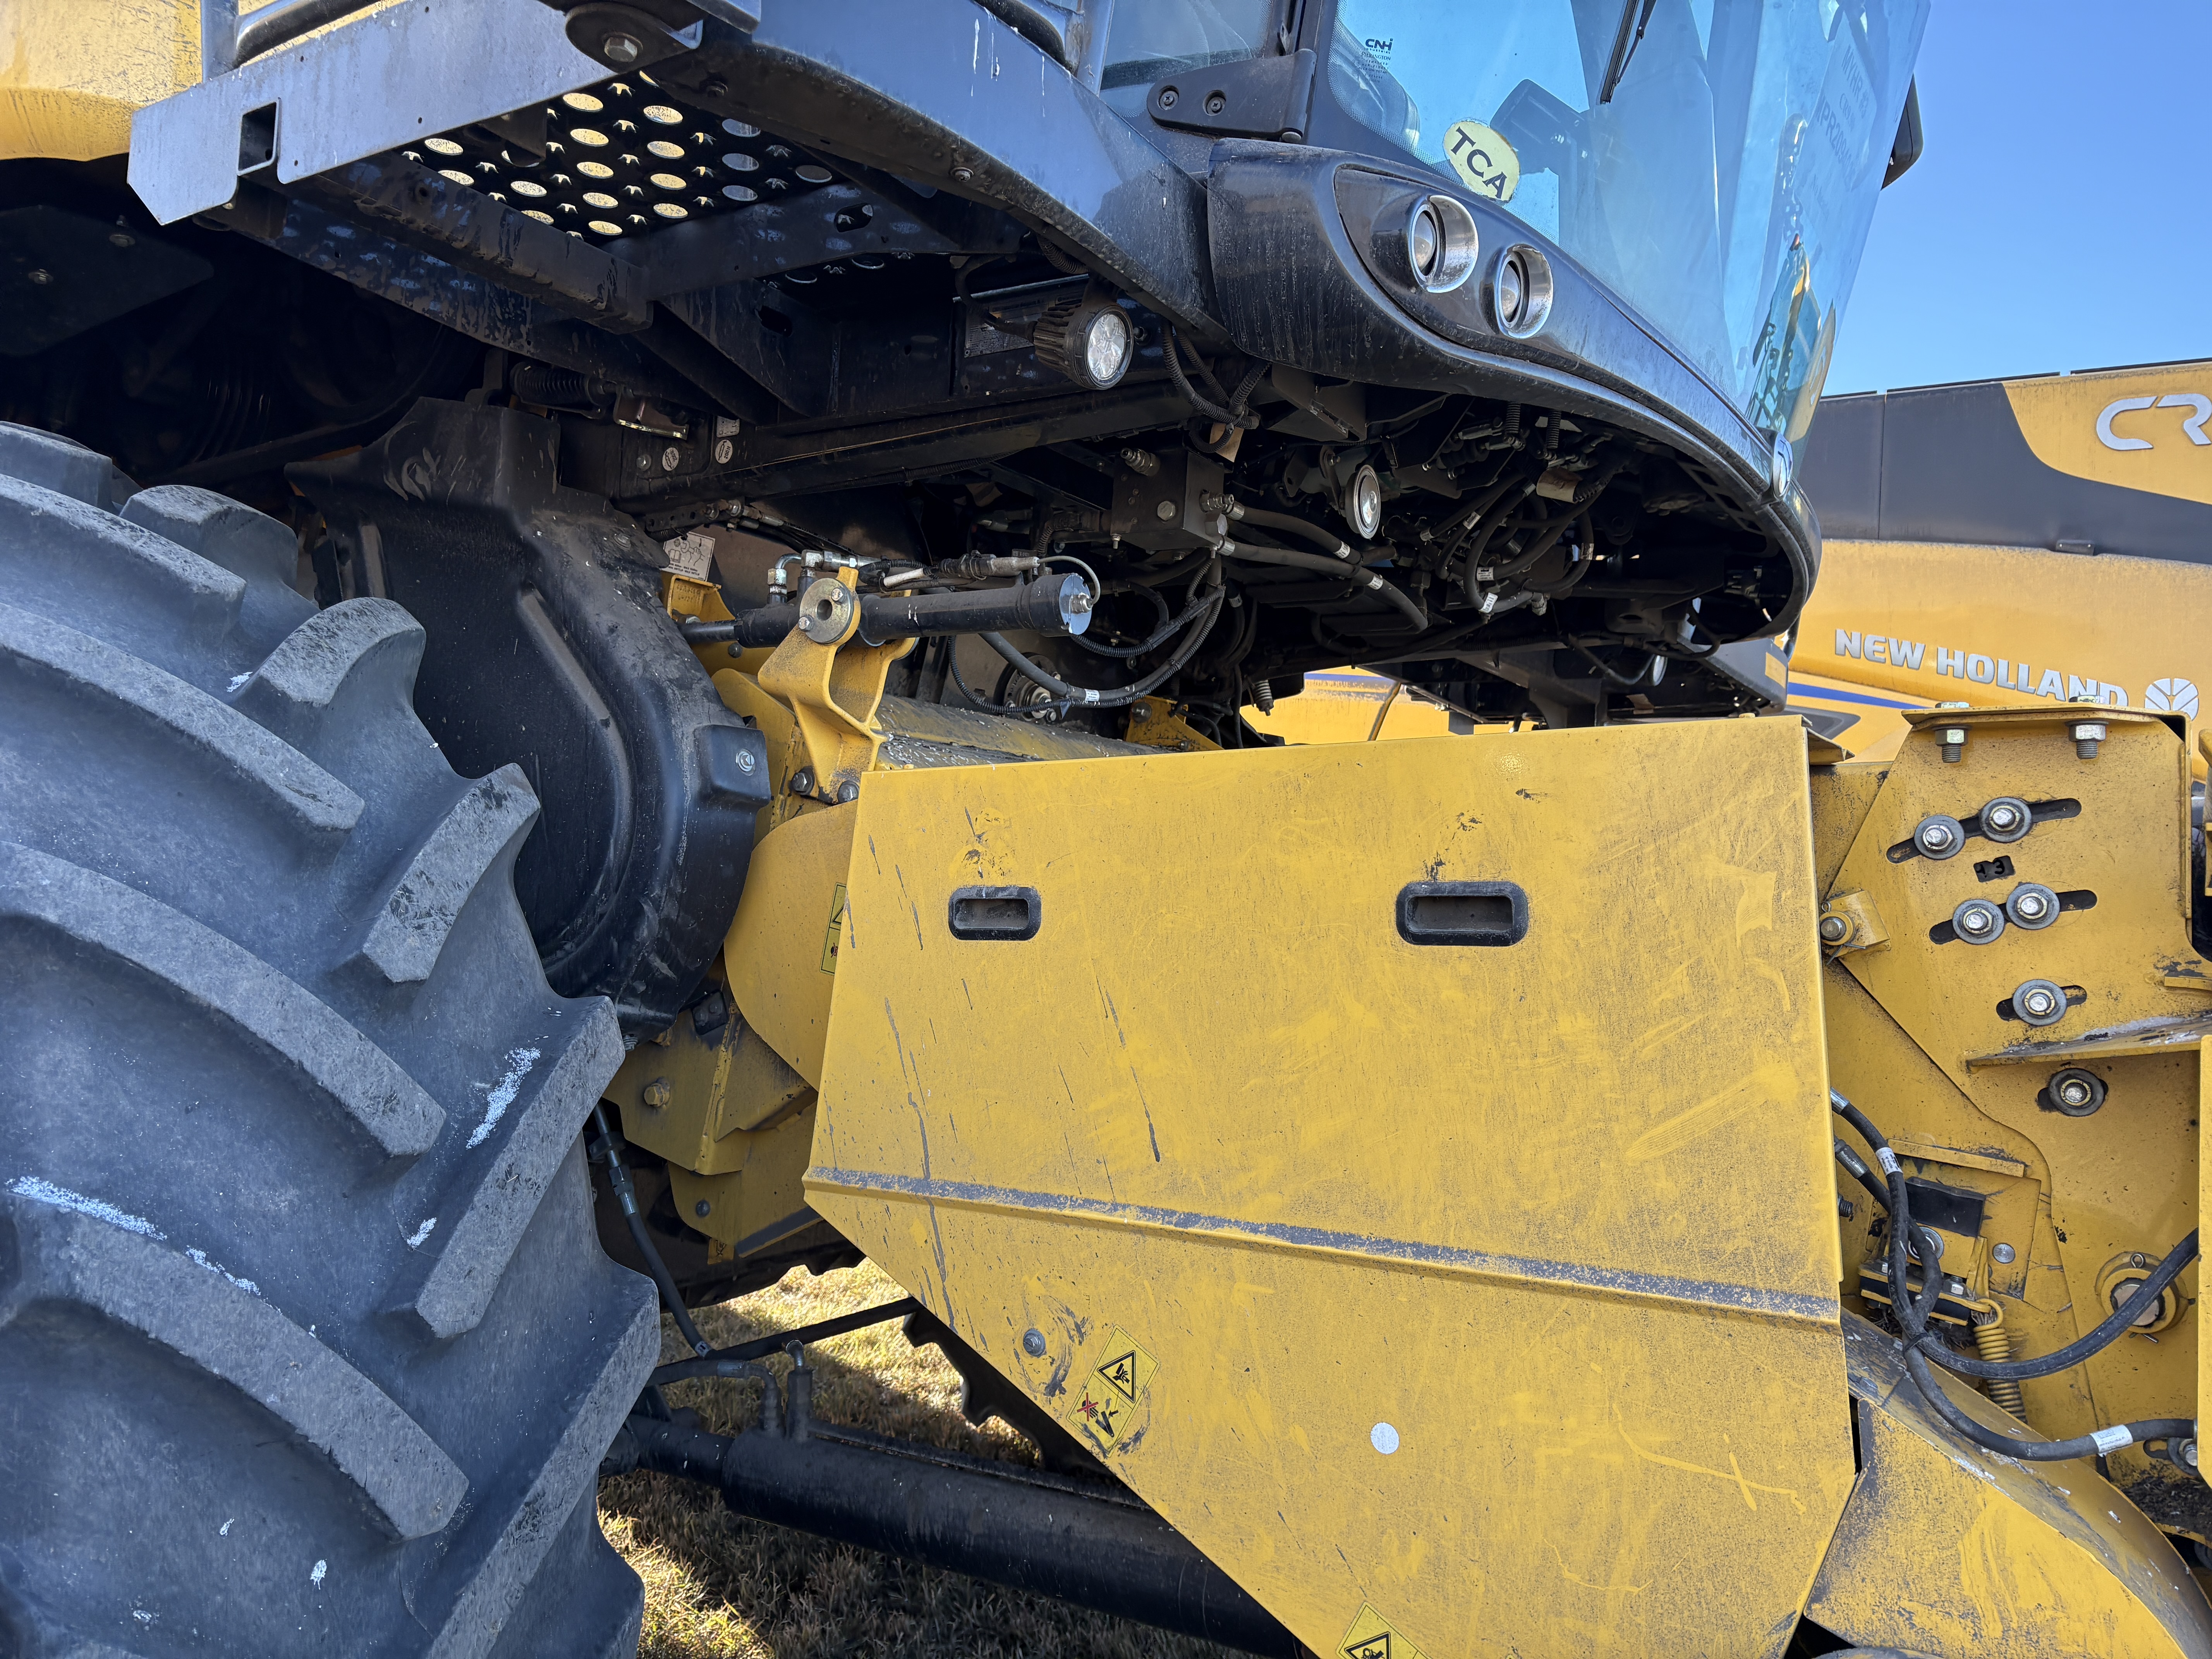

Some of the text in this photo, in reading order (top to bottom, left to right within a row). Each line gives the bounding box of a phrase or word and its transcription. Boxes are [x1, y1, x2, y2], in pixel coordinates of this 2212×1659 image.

[1365, 38, 1393, 51] CNH
[1451, 126, 1507, 199] TCA
[2096, 393, 2212, 451] CR
[1835, 629, 2129, 706] NEW HOLLAND
